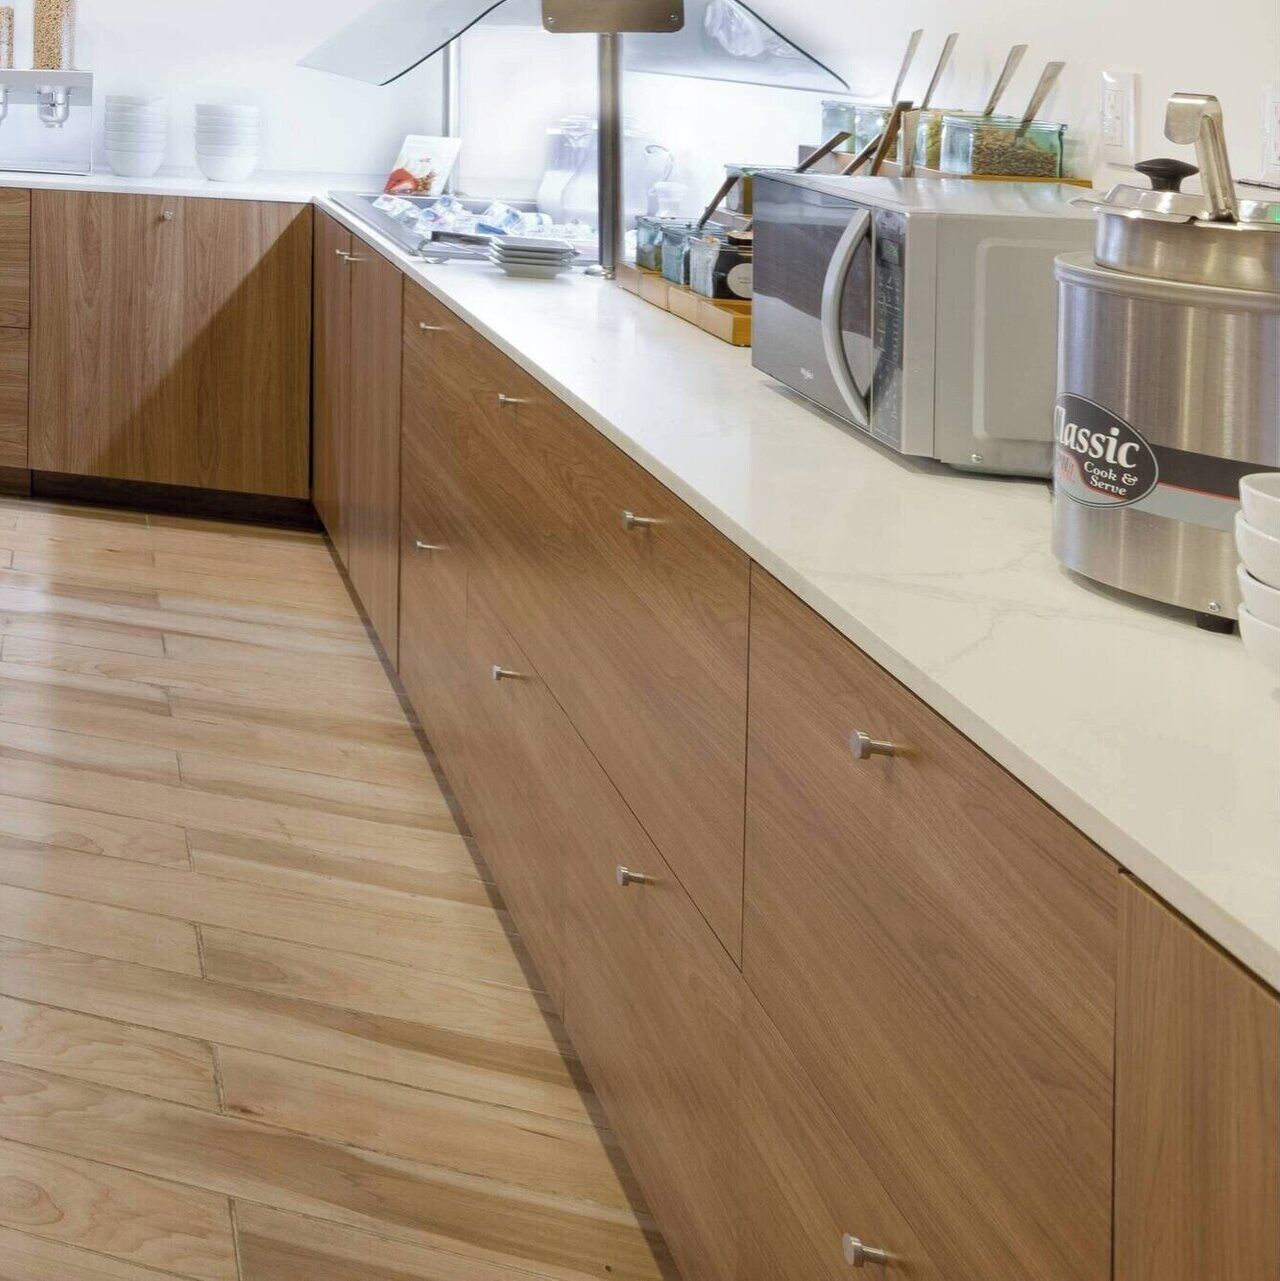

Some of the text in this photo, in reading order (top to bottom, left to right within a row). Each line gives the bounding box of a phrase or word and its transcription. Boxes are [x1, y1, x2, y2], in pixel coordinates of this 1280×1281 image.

[1084, 461, 1117, 481] Cook
[1122, 473, 1138, 486] &
[1090, 475, 1127, 496] Serve
